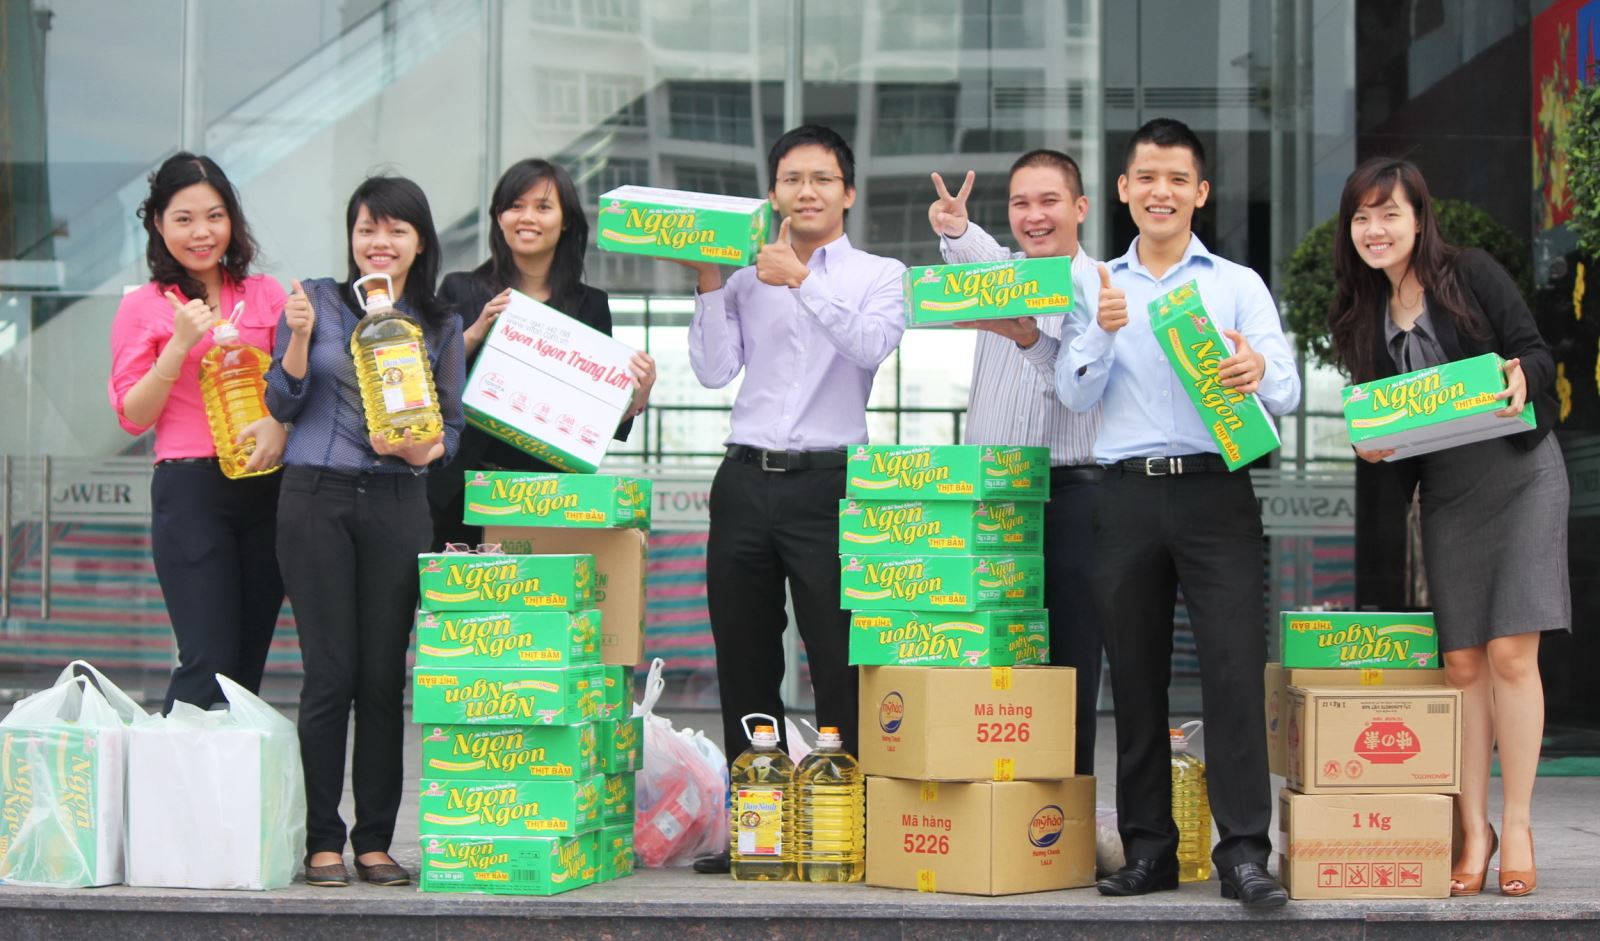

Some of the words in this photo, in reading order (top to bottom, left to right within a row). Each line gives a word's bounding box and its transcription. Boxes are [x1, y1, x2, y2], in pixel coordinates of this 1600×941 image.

[626, 208, 695, 233] Ngon
[656, 228, 715, 248] Ngon
[944, 268, 1015, 296] Ngon
[979, 280, 1039, 307] Ngon
[501, 324, 533, 347] Ngon
[533, 337, 568, 362] Ngon
[1373, 372, 1440, 411] Ngon
[1407, 382, 1465, 417] Ngon
[1195, 379, 1244, 431] Ngon
[871, 452, 931, 478] Ngon
[899, 465, 948, 489] Ngon
[491, 479, 559, 503] Ngon
[521, 493, 578, 516] Ngon
[863, 506, 923, 531] Ngon
[890, 520, 940, 544] Ngon
[447, 564, 518, 589] Ngon
[864, 563, 924, 588] Ngon
[480, 577, 540, 602] Ngon
[891, 577, 942, 601] Ngon
[441, 618, 511, 644] Ngon
[879, 621, 931, 644] Ngon
[1318, 623, 1378, 649] Ngon
[474, 632, 533, 657] Ngon
[898, 634, 962, 659] Ngon
[1340, 637, 1410, 662] Ngon
[445, 679, 503, 703] Ngon
[465, 693, 535, 718] Ngon
[974, 703, 994, 716] Mã
[999, 703, 1033, 718] hàng
[977, 723, 1030, 742] 5226
[1363, 731, 1413, 750] 味の素
[453, 733, 524, 758] Ngon
[486, 747, 545, 771] Ngon
[447, 788, 517, 813] Ngon
[480, 801, 539, 826] Ngon
[902, 814, 919, 827] Mã
[922, 815, 952, 831] hàng
[1353, 813, 1361, 828] 1
[1368, 813, 1392, 830] Kg
[444, 843, 494, 859] Ngon
[904, 834, 949, 855] 5226
[467, 853, 508, 869] Ngon
